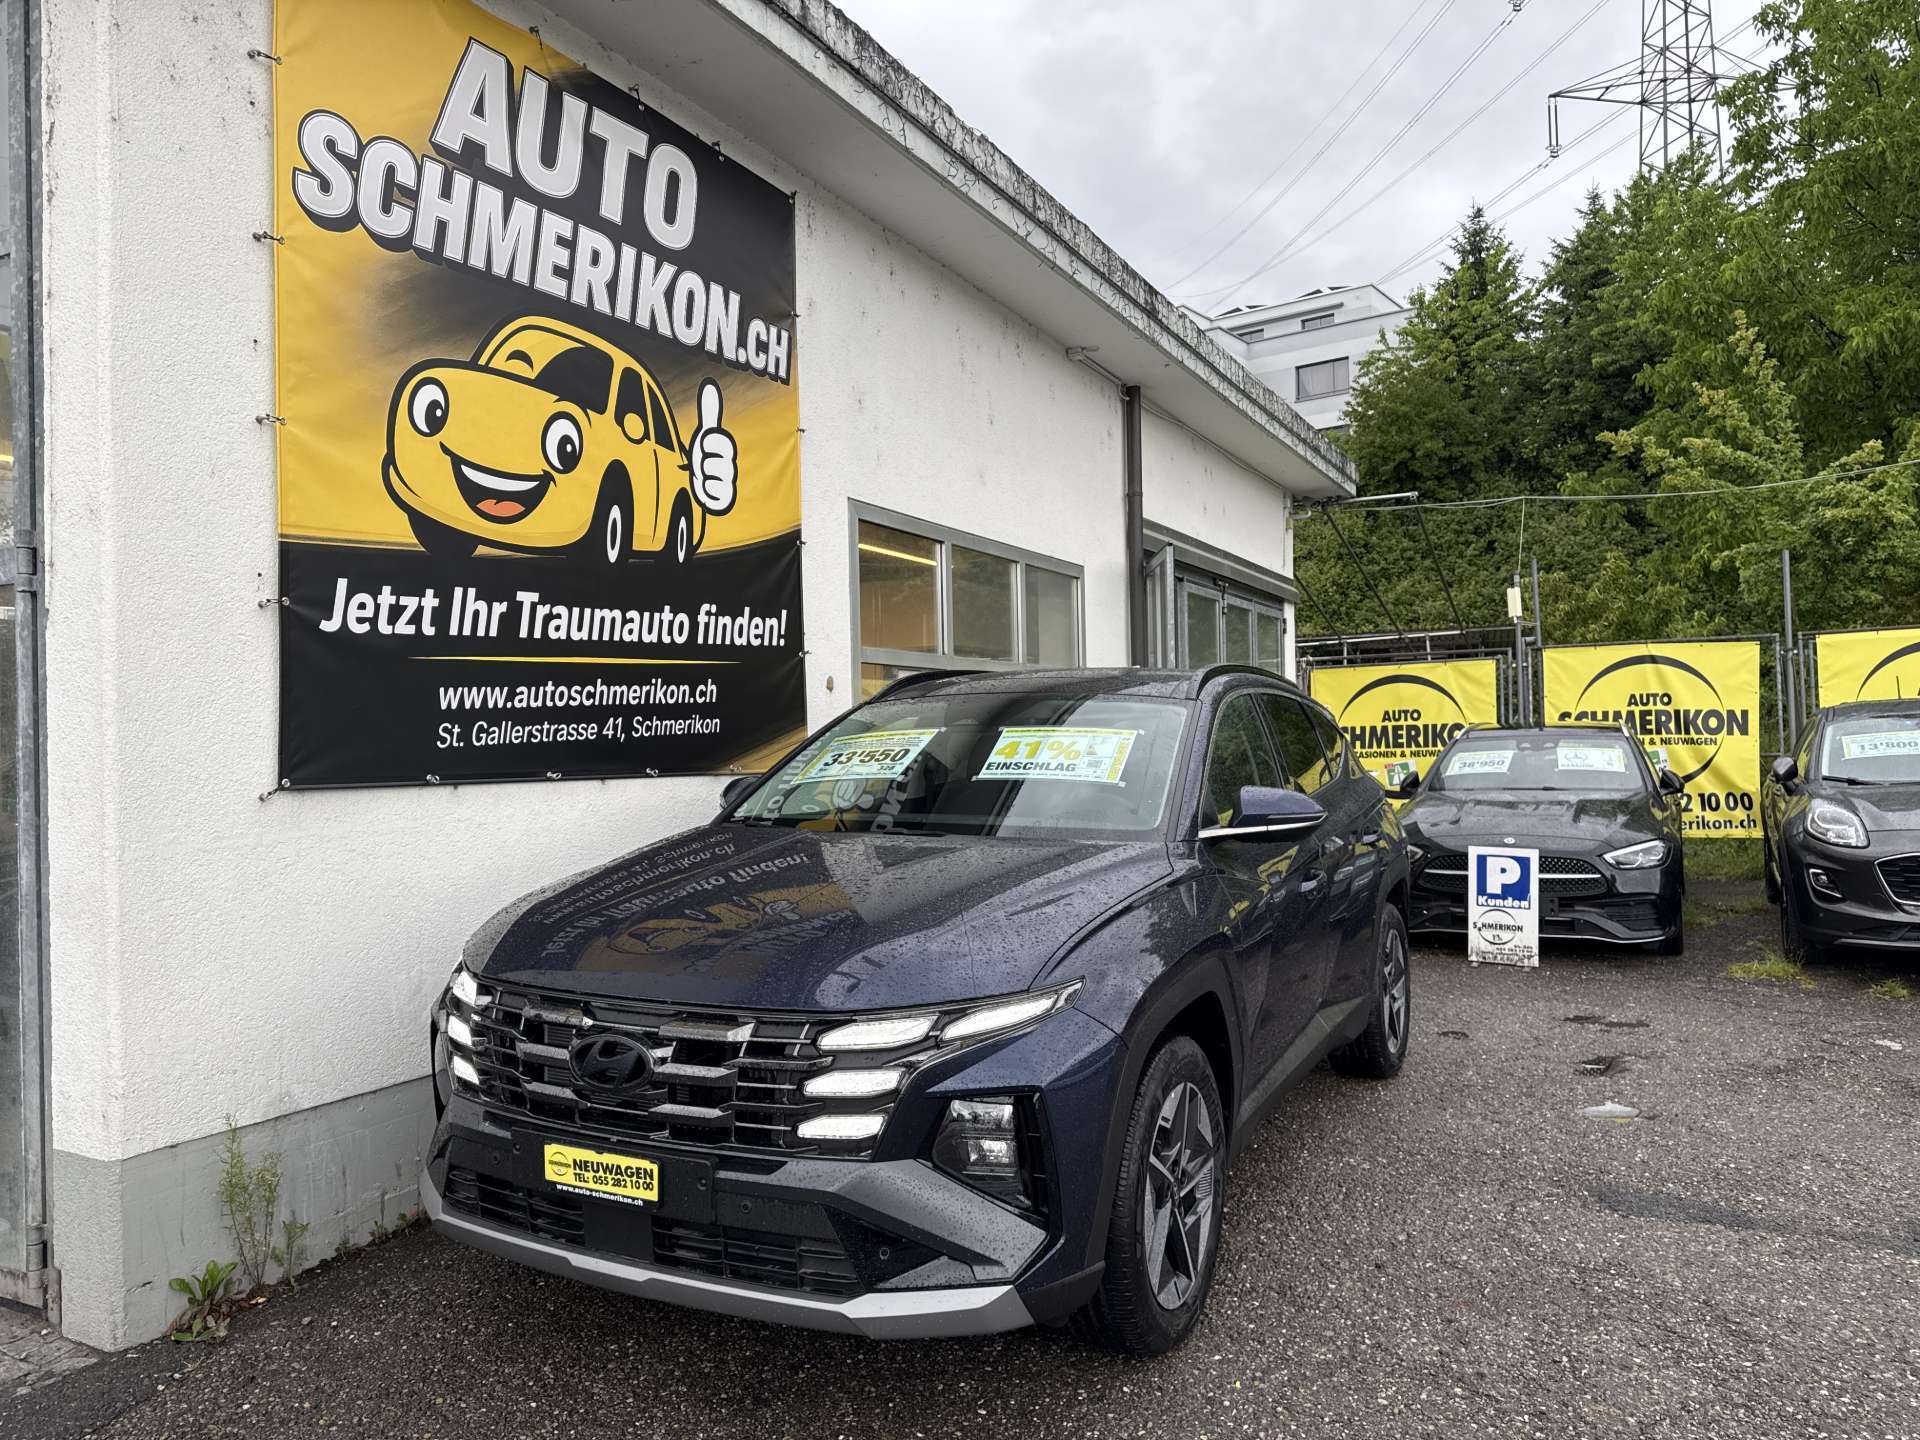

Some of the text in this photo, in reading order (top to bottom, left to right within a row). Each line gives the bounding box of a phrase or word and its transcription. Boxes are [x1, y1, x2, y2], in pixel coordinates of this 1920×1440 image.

[431, 37, 698, 251] AUTO
[294, 112, 790, 383] SCHMERIKON.CH
[319, 578, 788, 647] Jetzt Ihr Traumauto finden!
[438, 678, 718, 710] www.autoschmerikon.ch
[1627, 693, 1673, 707] AUTO
[1381, 709, 1422, 723] AUTO
[436, 715, 721, 749] St. Gallerstrasse 41, Schmerikon
[1649, 737, 1657, 746] &
[1660, 736, 1718, 746] NEUWAGEN
[823, 748, 911, 767] 33'550
[994, 739, 1081, 761] 41%
[1399, 750, 1407, 758] &
[985, 761, 1078, 772] EINSCHLAG
[1458, 759, 1505, 769] 38'950
[1698, 792, 1721, 812] 10
[1725, 791, 1754, 811] 00
[1486, 855, 1521, 894] P
[1478, 895, 1529, 909] Kunden
[1472, 921, 1524, 933] SHMERIKON
[572, 1158, 654, 1181] NEUWAGEN
[573, 1172, 654, 1192] TEL: 055 282 10 00
[556, 1183, 644, 1206] www.auto-schmerikon.ch
